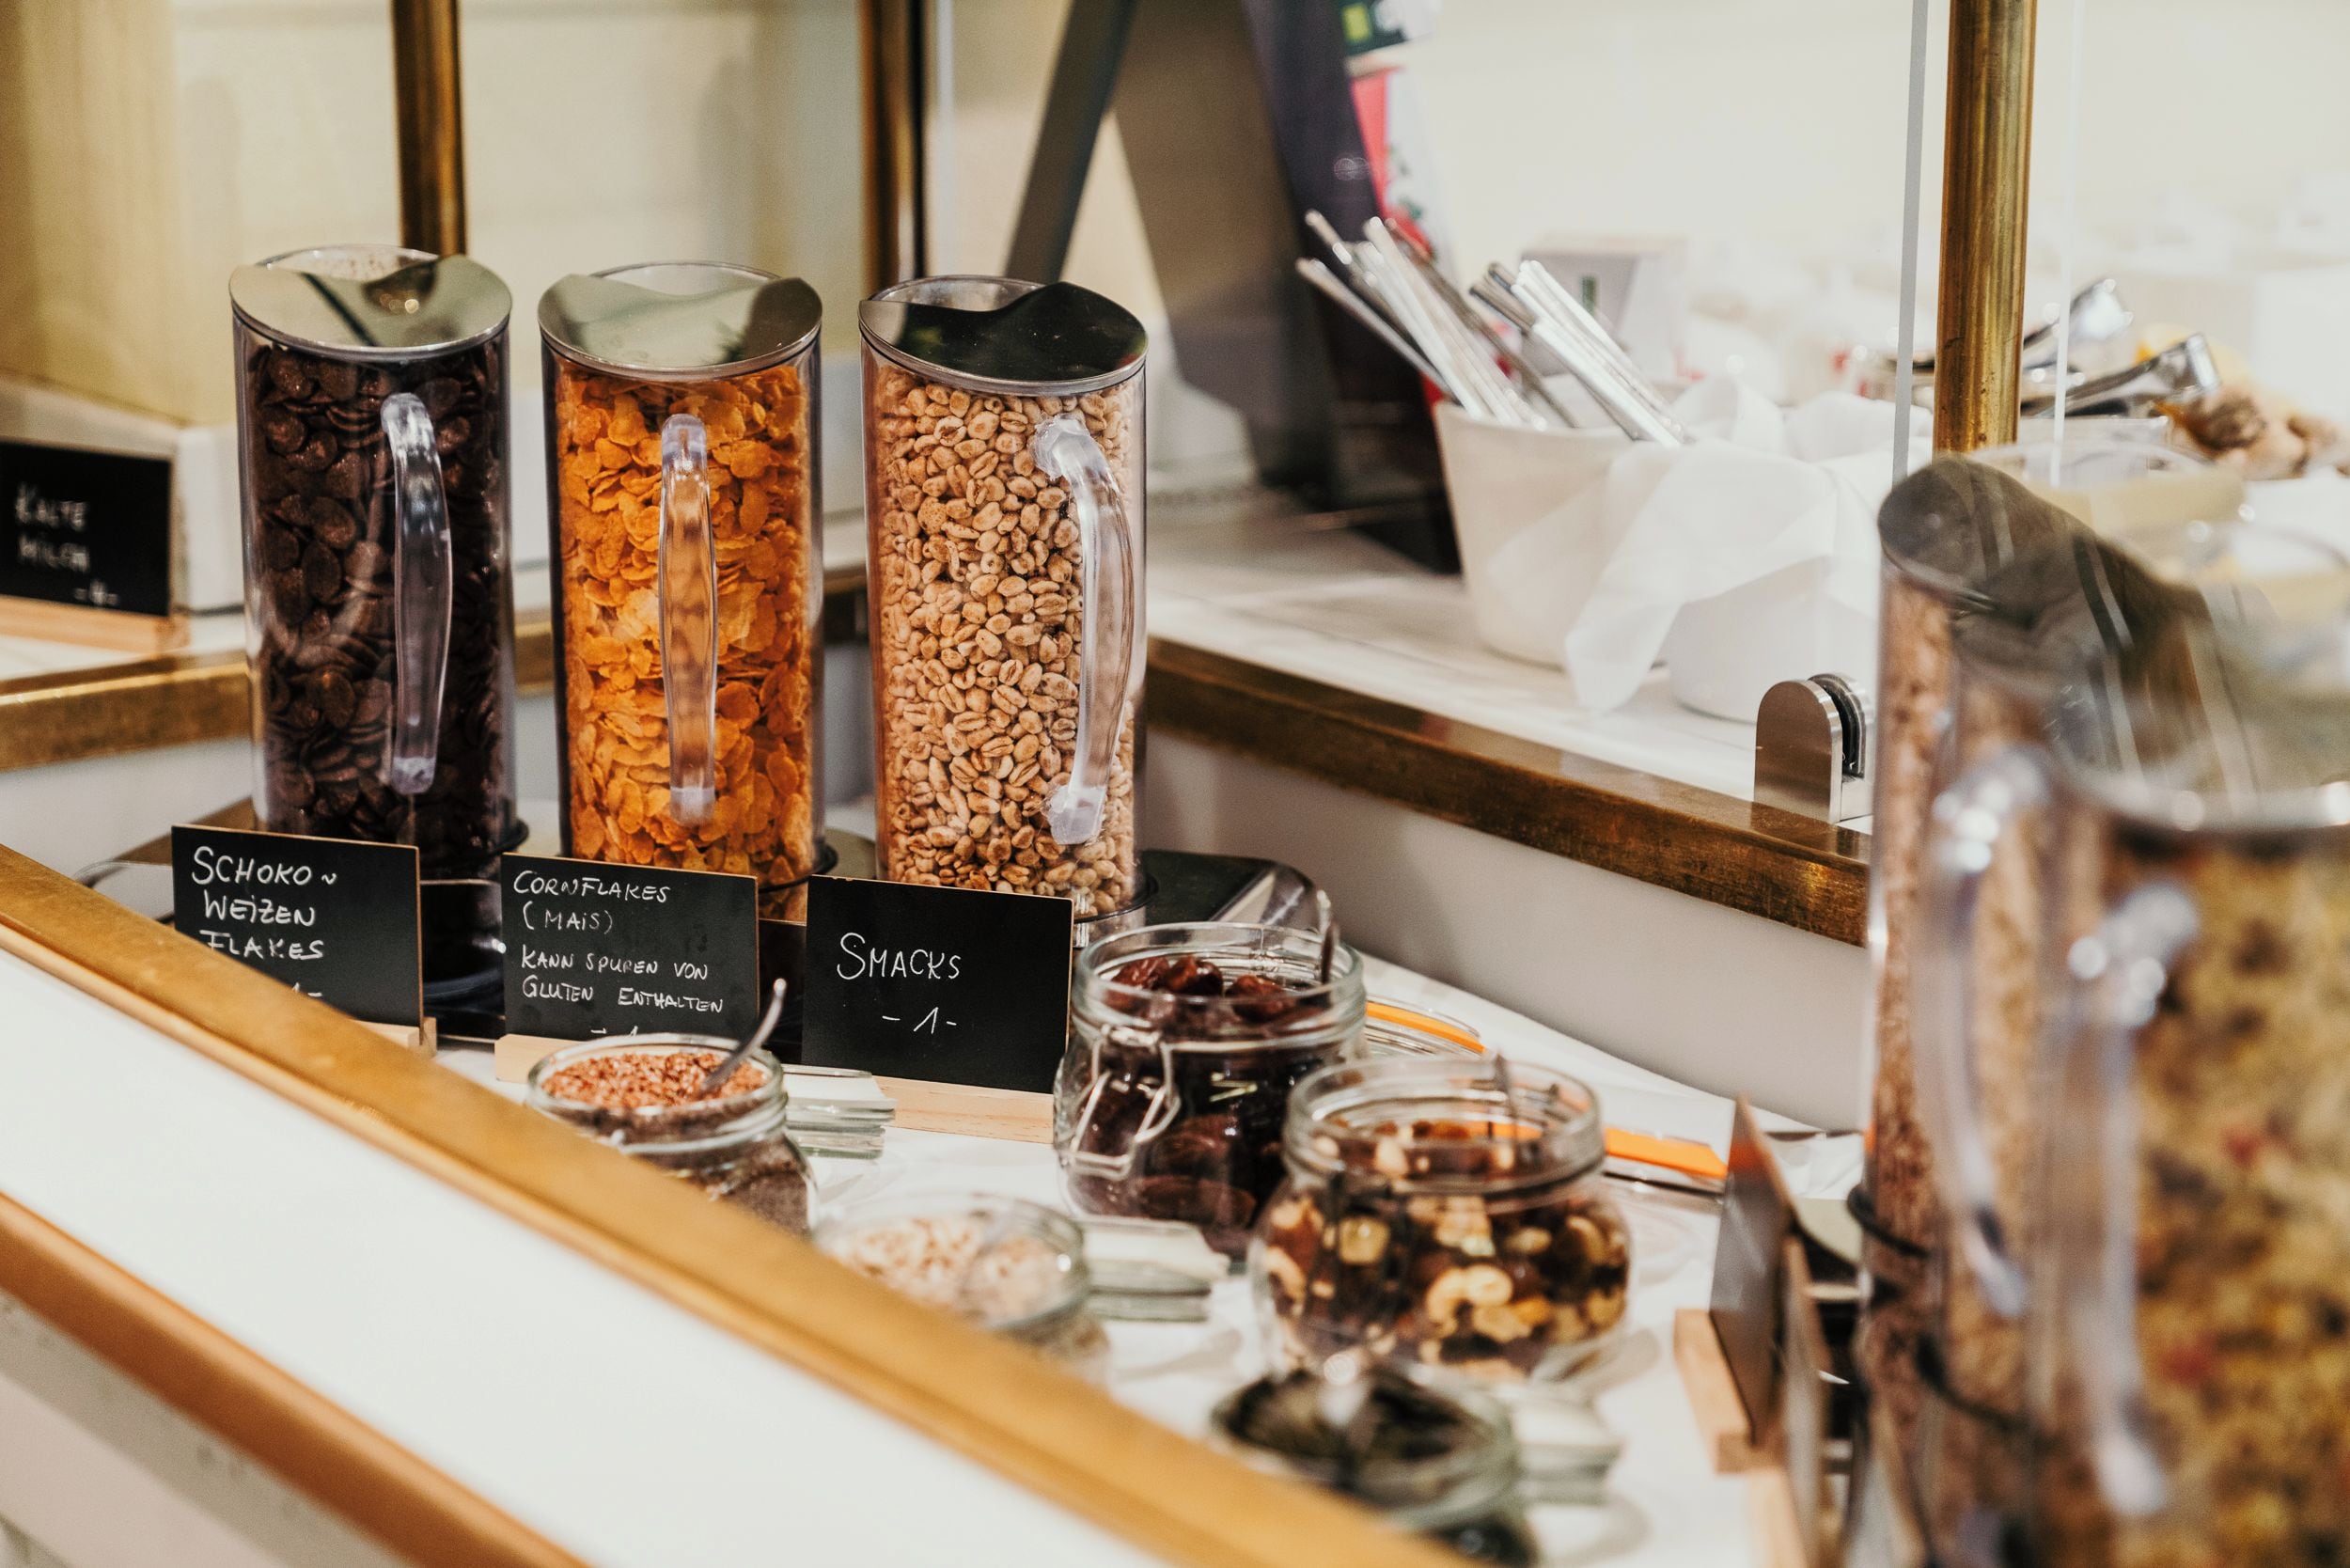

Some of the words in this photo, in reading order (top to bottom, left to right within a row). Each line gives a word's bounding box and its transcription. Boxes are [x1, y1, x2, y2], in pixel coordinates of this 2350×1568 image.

[512, 870, 672, 903] CORNFLAKES
[199, 930, 324, 961] FLAKES
[521, 944, 574, 969] KANN
[586, 952, 659, 975] SPUREN
[673, 962, 709, 980] VON
[836, 932, 962, 980] SMACKS
[522, 974, 594, 1001] GLUTEN
[617, 987, 724, 1013] ENTHALTEN
